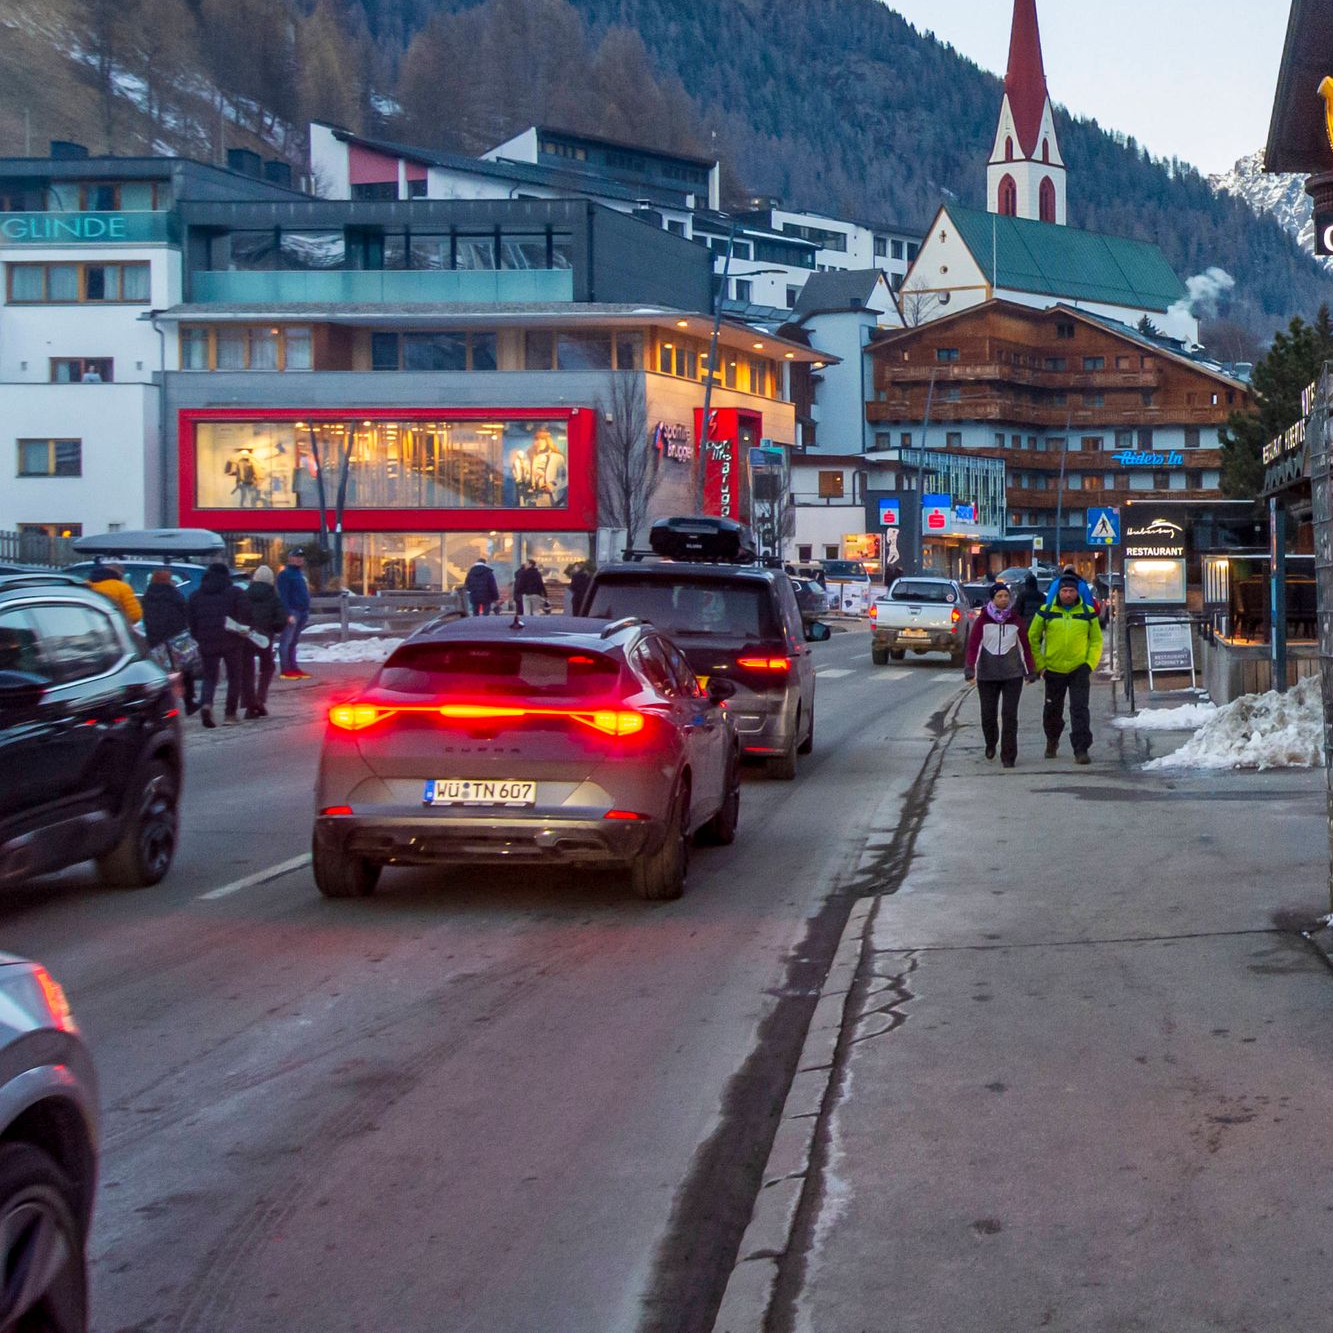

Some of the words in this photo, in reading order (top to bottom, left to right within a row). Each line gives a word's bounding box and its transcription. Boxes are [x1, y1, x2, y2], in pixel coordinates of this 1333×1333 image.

[1, 217, 125, 238] GLINDE
[1111, 450, 1164, 465] Riders
[1126, 547, 1184, 556] RESTAURANT
[437, 782, 460, 798] WÜ
[473, 783, 496, 798] TN
[499, 783, 533, 799] 607
